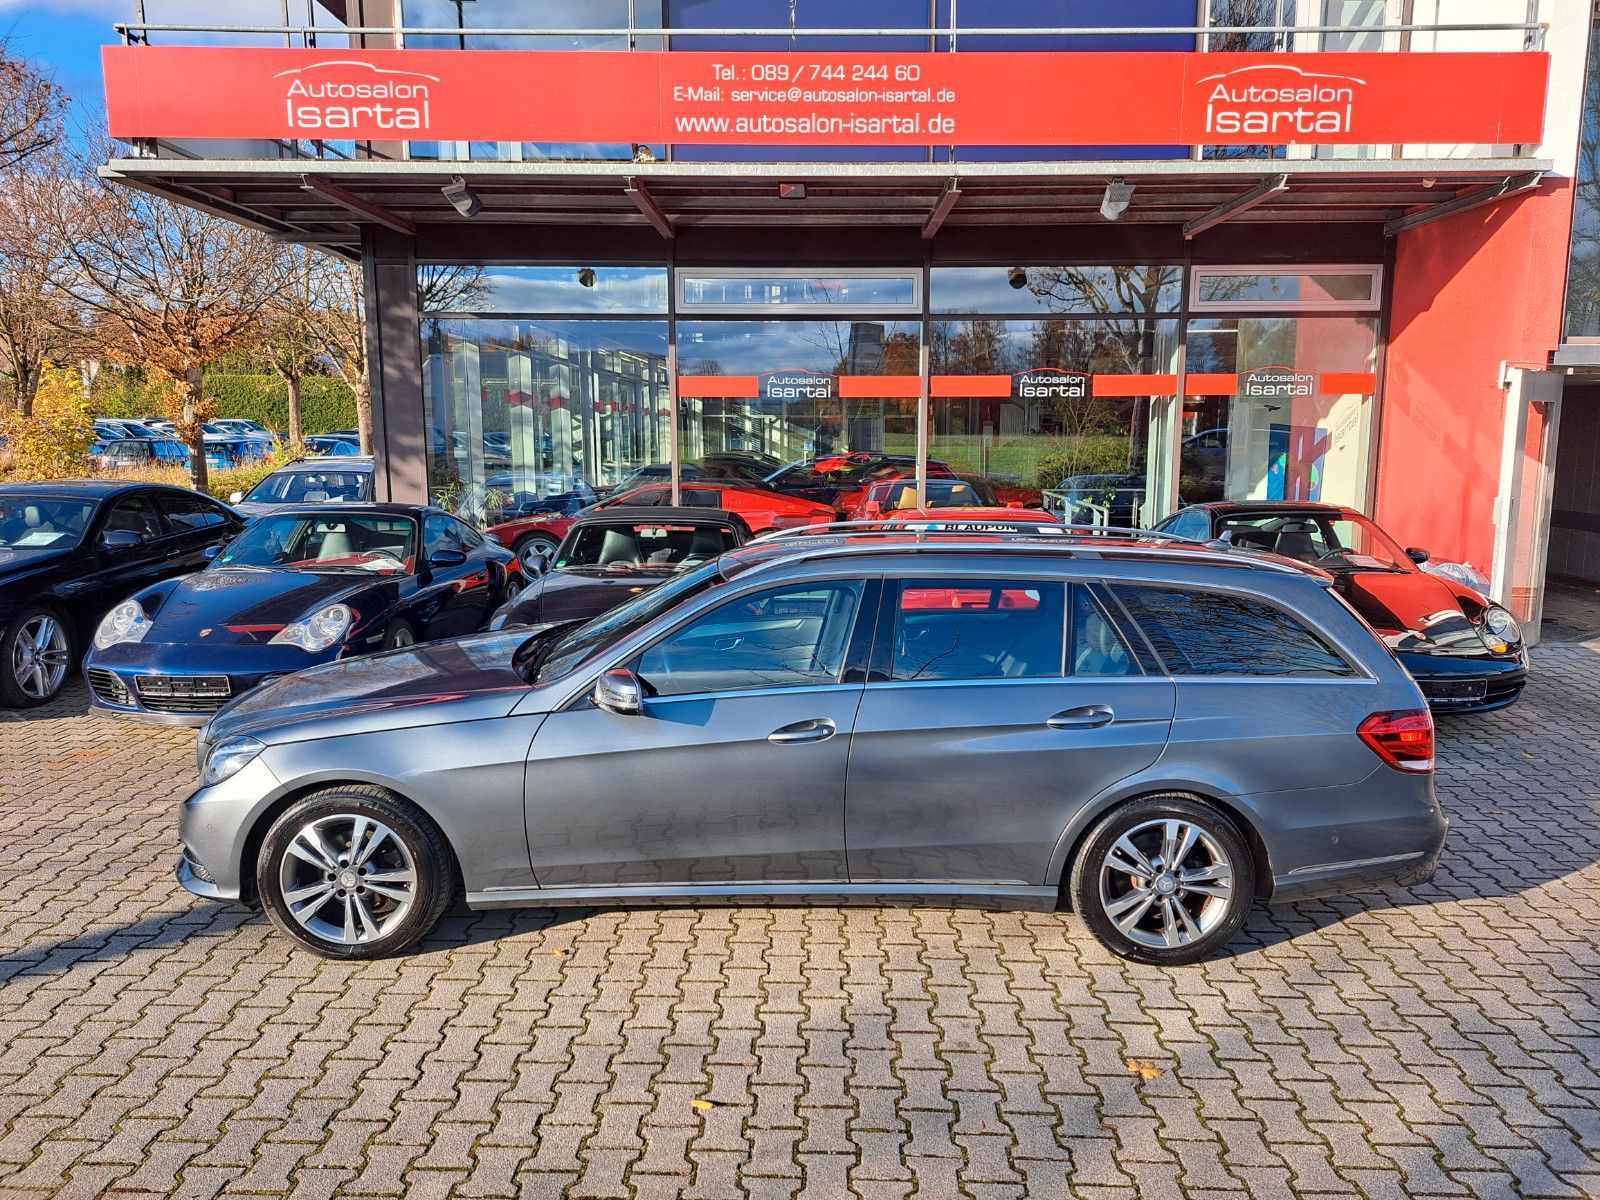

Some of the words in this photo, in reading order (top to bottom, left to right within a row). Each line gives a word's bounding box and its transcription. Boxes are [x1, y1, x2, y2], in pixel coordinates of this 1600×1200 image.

[712, 65, 747, 81] Tel.:
[751, 65, 789, 81] 089
[809, 65, 846, 81] 744
[852, 65, 889, 81] 244
[895, 65, 921, 81] 60
[287, 79, 429, 98] Autosalon
[673, 86, 725, 102] E-Mail:
[731, 86, 956, 104] service@autosalon-isartal.de
[1208, 83, 1353, 103] Autosalon
[286, 98, 430, 129] Isartal
[1205, 103, 1352, 133] Isartal
[675, 112, 956, 135] www.autosalon-isartal.de
[767, 375, 831, 385] Autosalon
[1020, 374, 1085, 384] Autosalon
[1247, 373, 1313, 382] Autosalon
[767, 384, 831, 398] Isartal
[1019, 383, 1085, 397] Isartal
[1246, 382, 1313, 396] Isartal
